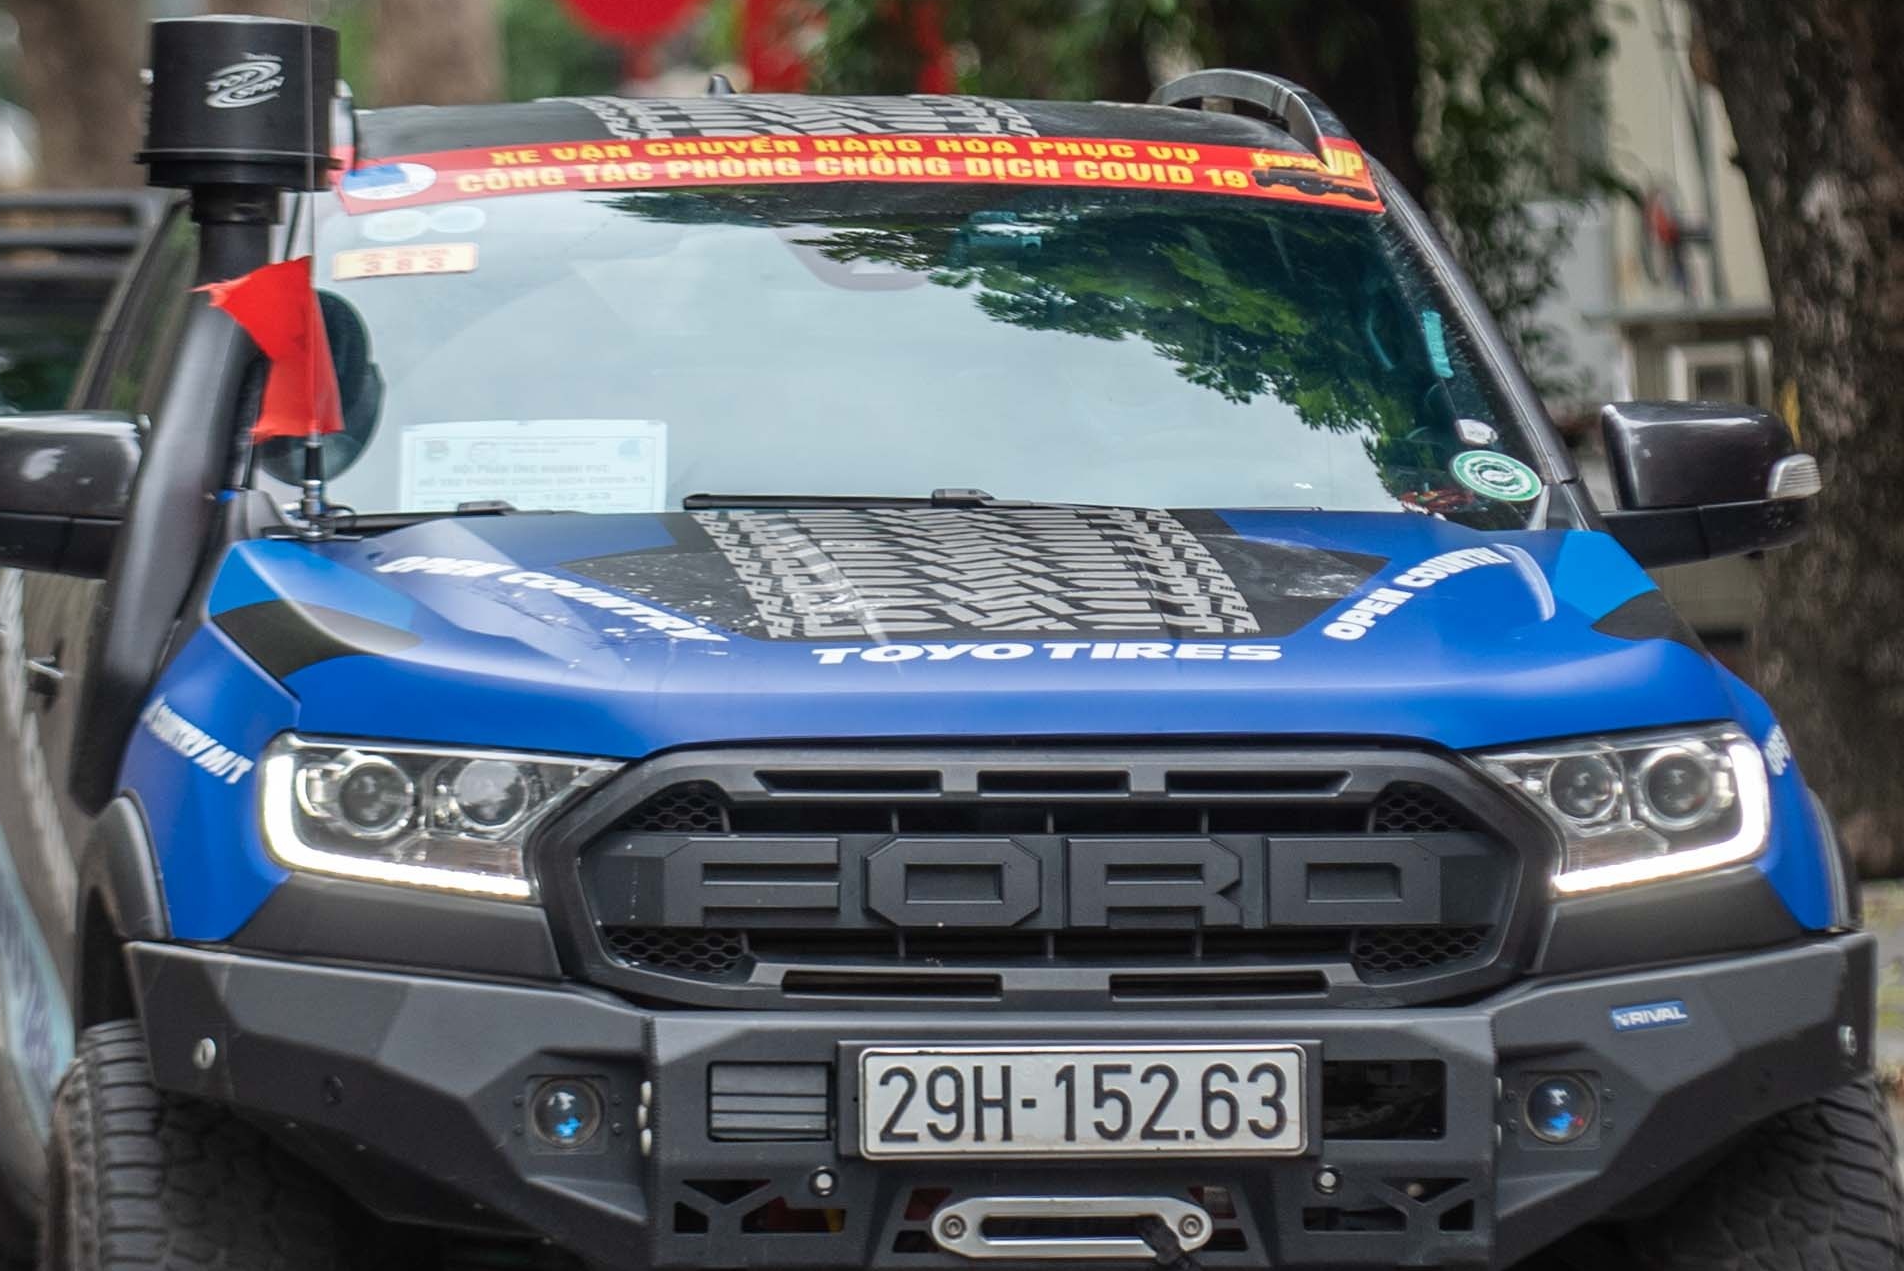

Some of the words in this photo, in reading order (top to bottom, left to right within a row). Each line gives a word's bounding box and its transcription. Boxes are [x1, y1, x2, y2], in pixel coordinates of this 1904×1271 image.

[489, 149, 542, 166] XE
[549, 143, 633, 163] VẬN
[644, 136, 801, 157] CHUYỂN
[812, 137, 924, 154] HÀNG
[1028, 140, 1136, 160] PHỤC
[1147, 145, 1201, 165] VỤ
[456, 167, 568, 193] CÔNG
[575, 160, 654, 184] TÁC
[664, 155, 802, 180] PHÒNG
[814, 151, 953, 176] CHỐNG
[963, 157, 1062, 180] DỊCH
[1073, 160, 1195, 185] COVID
[1204, 167, 1250, 189] 19
[374, 556, 517, 577] OPEN
[1322, 587, 1415, 641] OPEN
[811, 642, 1035, 665] TOYO
[1042, 641, 1283, 661] TIRES
[664, 835, 1441, 928] FORD
[1630, 1006, 1689, 1026] RIVAL
[877, 1063, 1287, 1144] 29H-152.63
